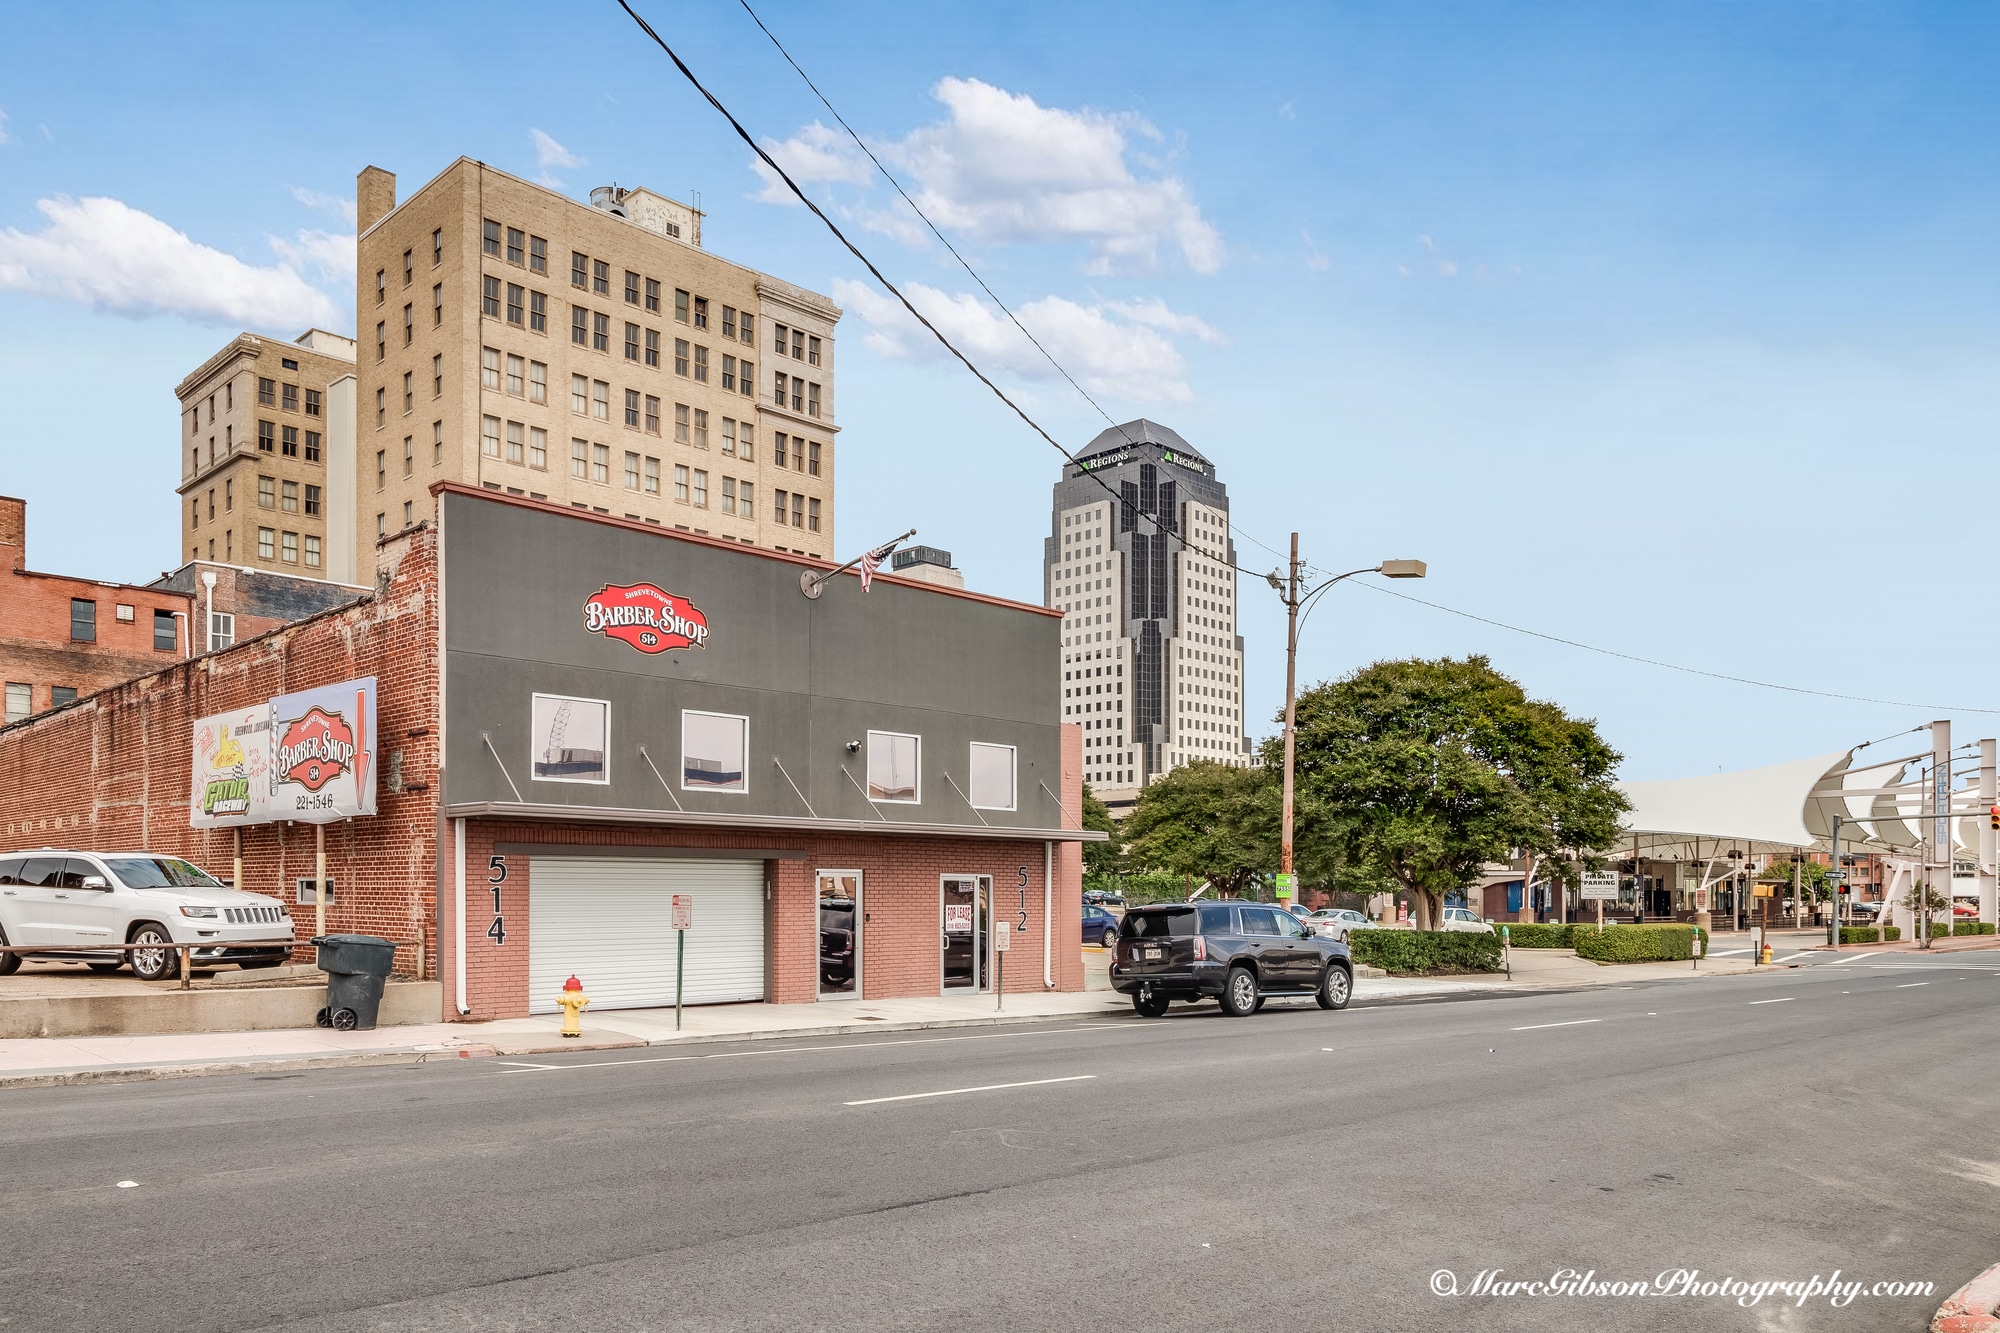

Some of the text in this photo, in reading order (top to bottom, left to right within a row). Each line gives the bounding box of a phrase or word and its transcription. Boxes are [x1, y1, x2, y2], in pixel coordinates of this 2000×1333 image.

[1090, 452, 1129, 469] REGIONS
[1173, 453, 1204, 473] REGIONS
[625, 588, 674, 607] SHREVETOWNE
[584, 602, 709, 645] BARBER SHOP
[641, 633, 657, 645] 514
[300, 715, 331, 733] SHREVETOWNE
[279, 730, 354, 777] BARBER SHOP
[309, 767, 320, 780] 514
[204, 778, 249, 811] GATOR
[213, 799, 248, 813] RACEWAY
[947, 907, 970, 922] FOR LEASE
